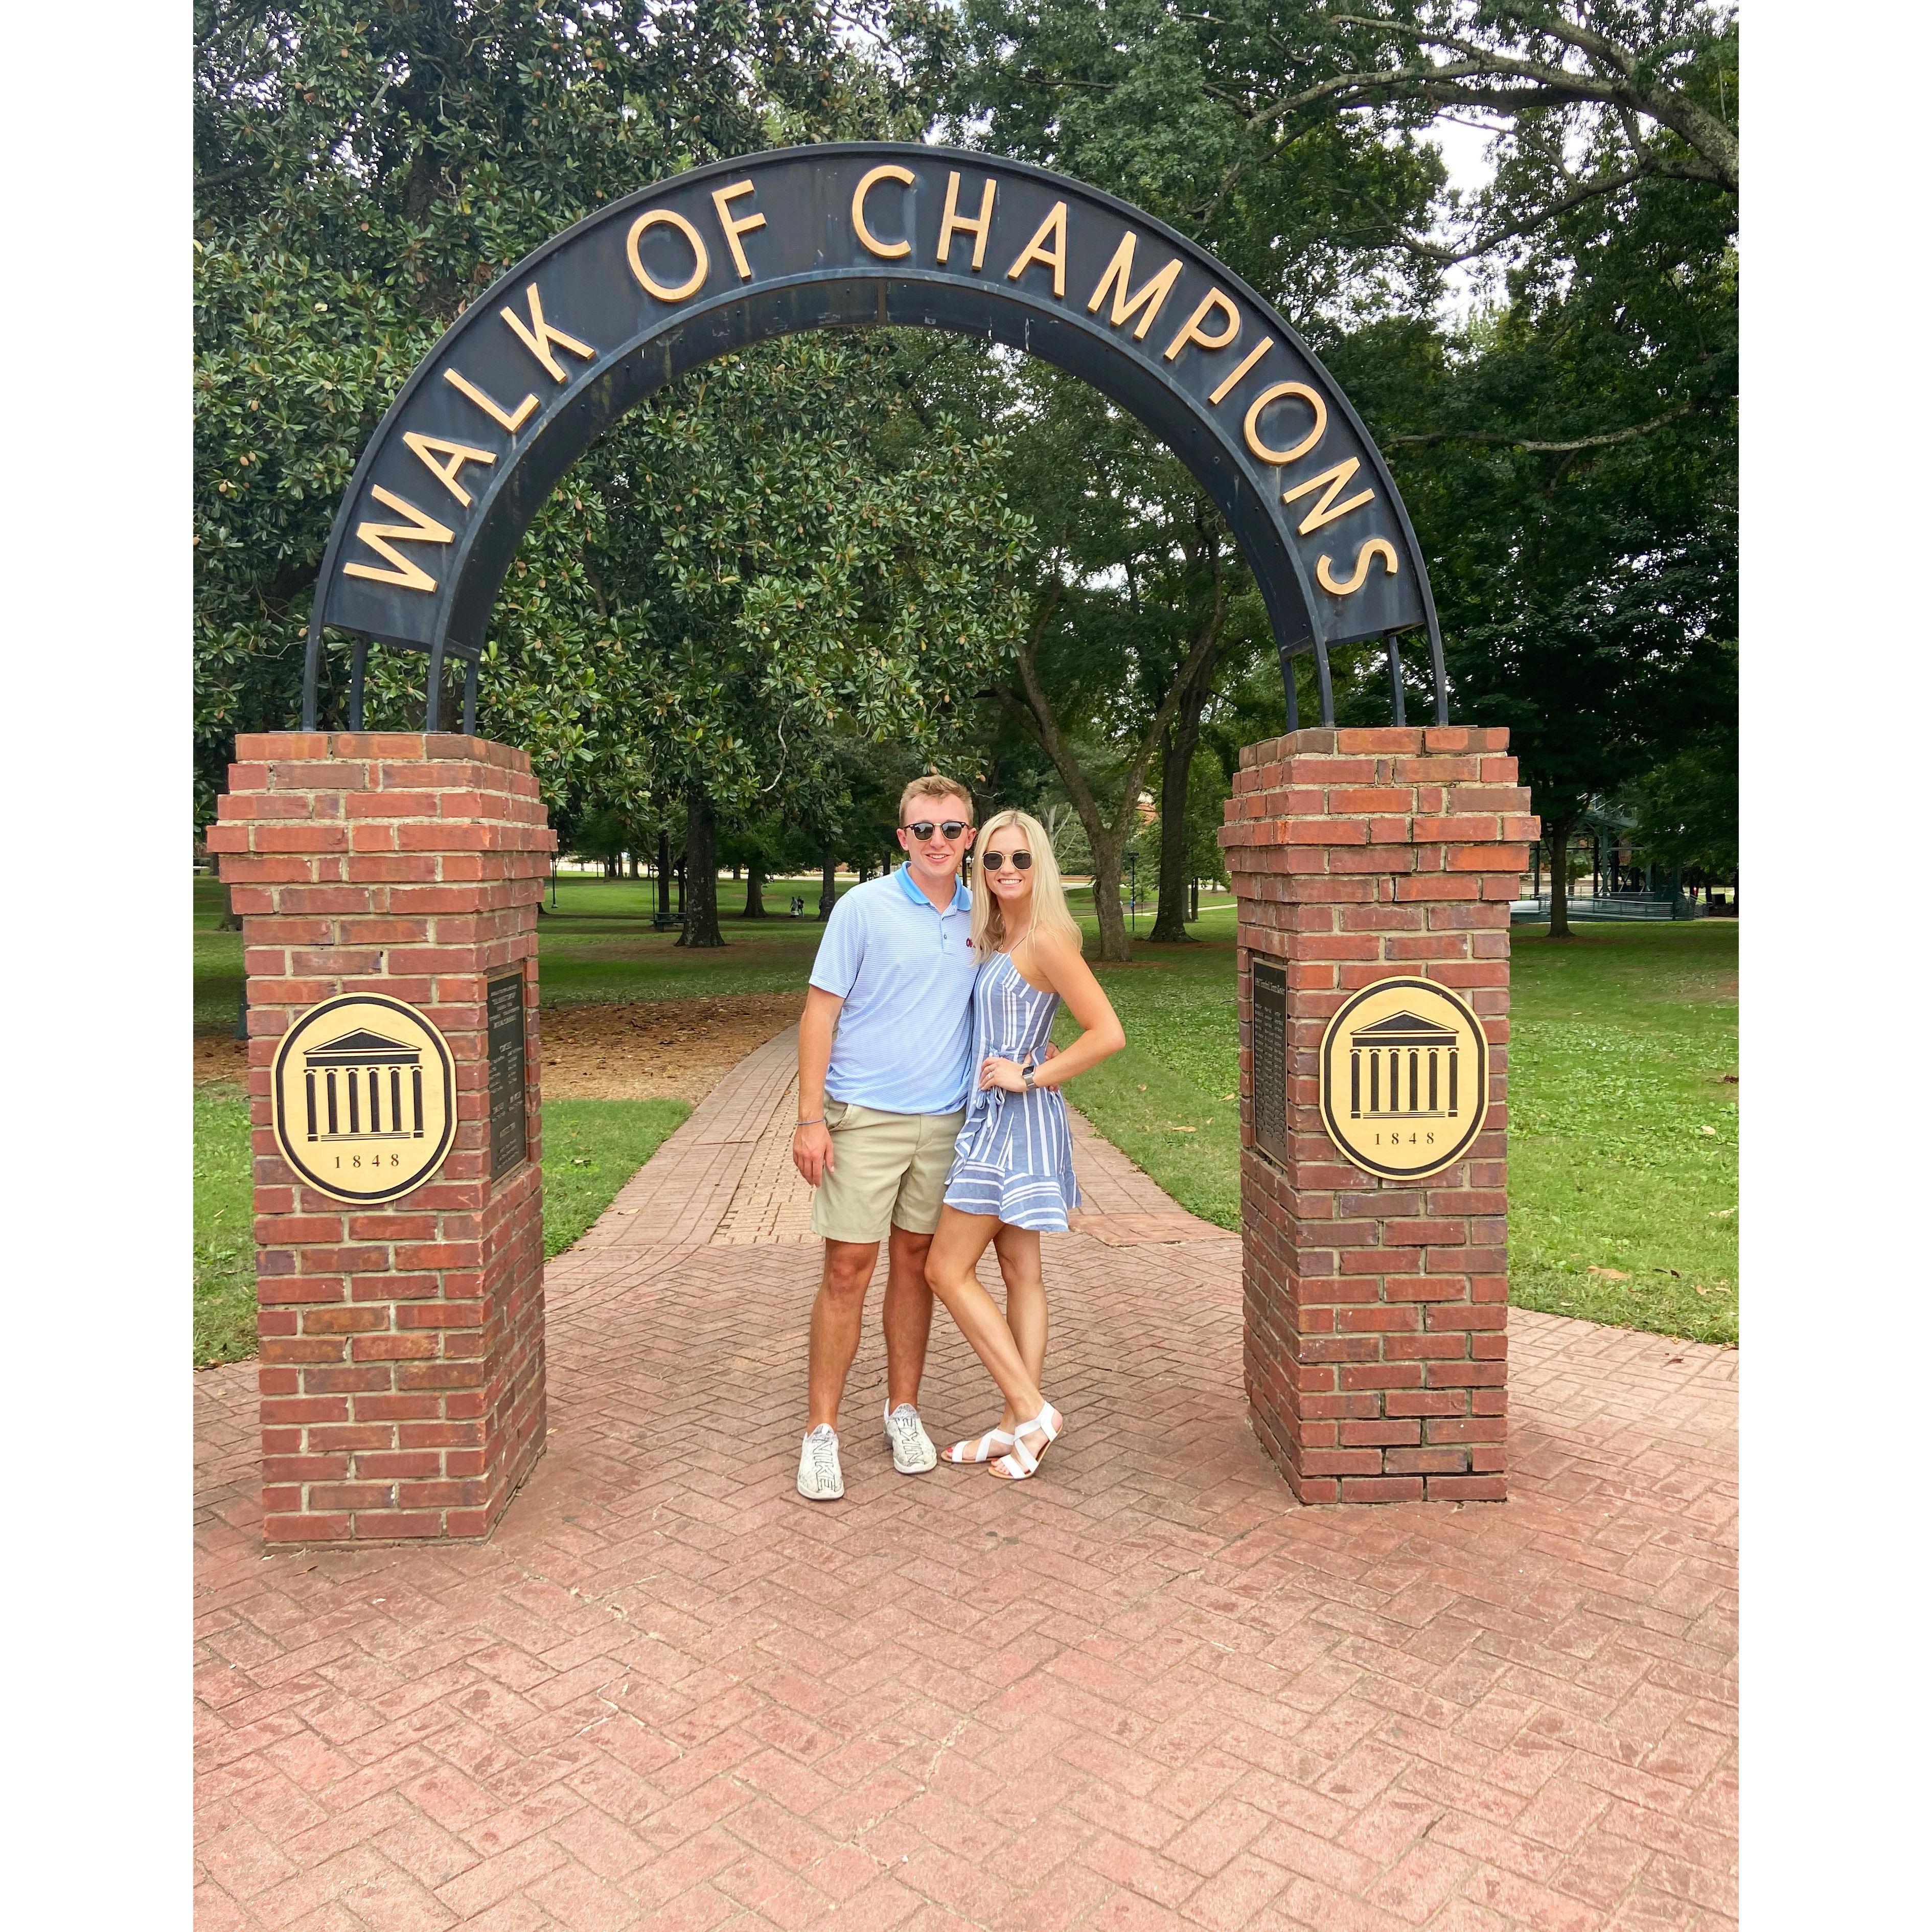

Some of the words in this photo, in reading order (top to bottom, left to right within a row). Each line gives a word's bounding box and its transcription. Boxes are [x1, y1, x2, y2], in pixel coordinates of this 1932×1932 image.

[343, 282, 595, 592] WALK
[626, 179, 767, 302] OF
[852, 165, 1398, 595] CHAMPIONS
[334, 1154, 399, 1168] 1848
[1375, 1132, 1434, 1145] 1848
[812, 1438, 836, 1492] NIKE
[894, 1417, 926, 1466] NIKE
